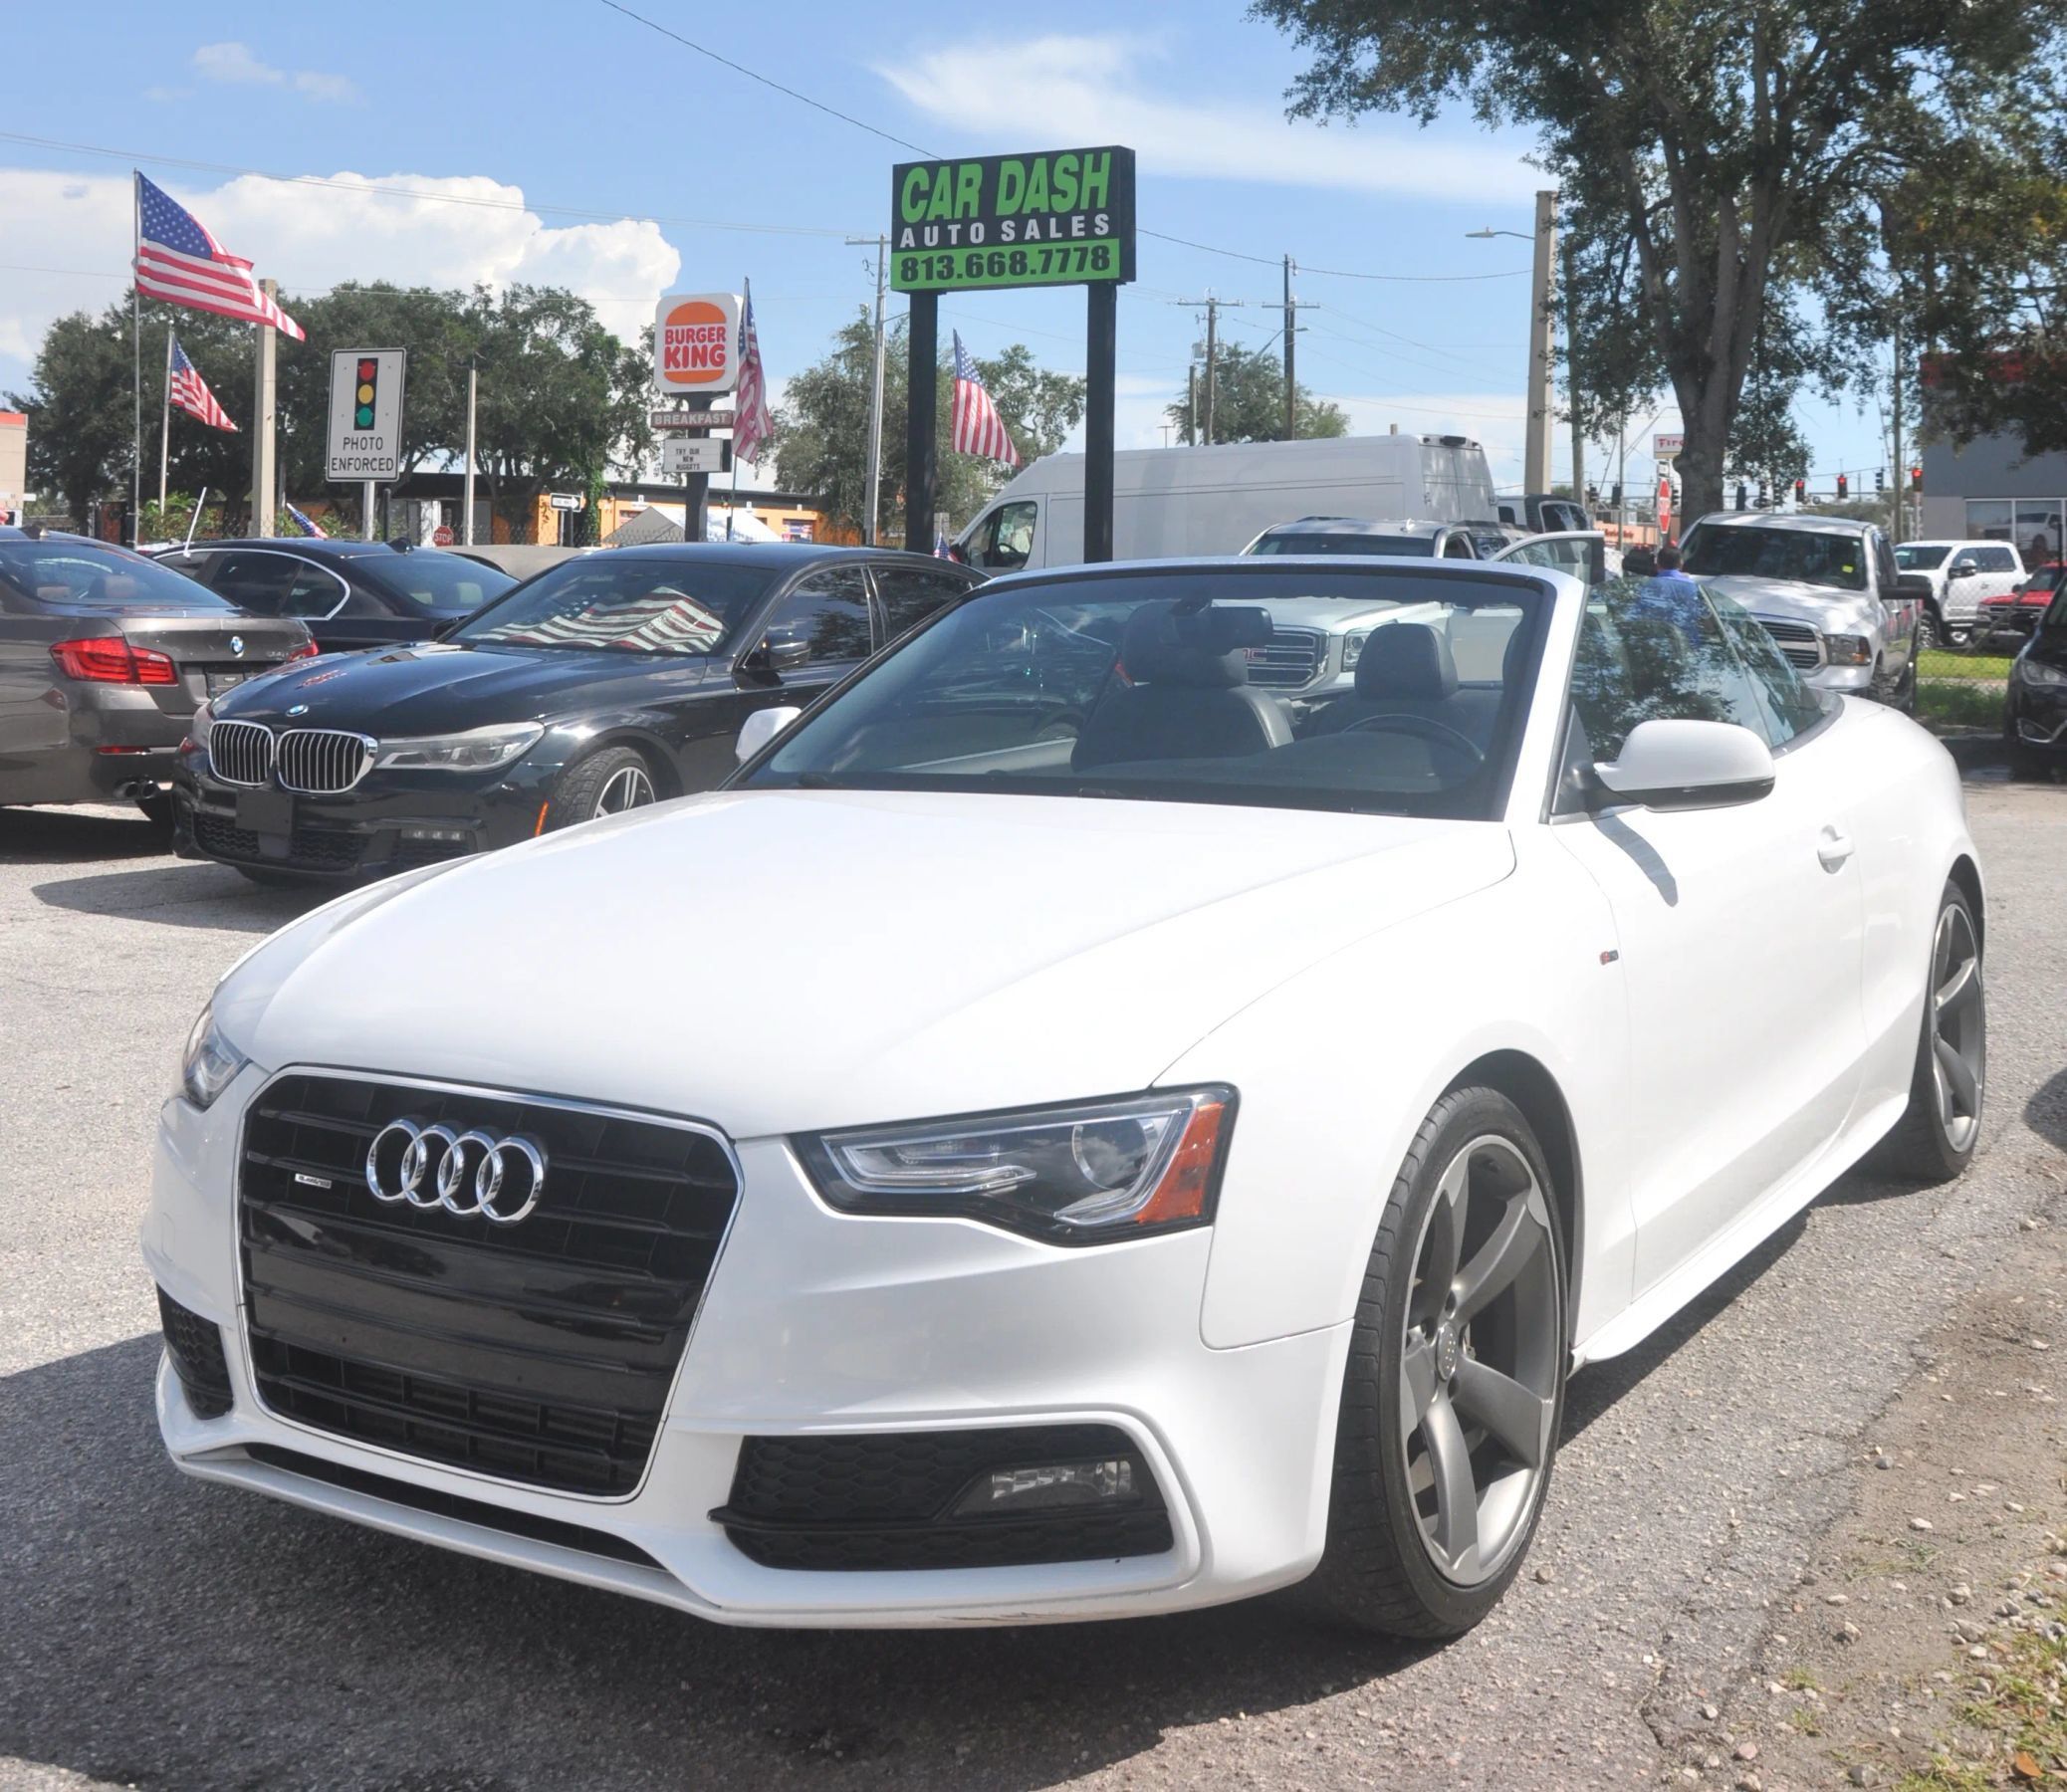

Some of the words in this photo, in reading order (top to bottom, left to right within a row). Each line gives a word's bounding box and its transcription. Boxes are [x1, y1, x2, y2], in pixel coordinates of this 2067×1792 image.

[901, 162, 984, 224] CAR
[996, 151, 1112, 216] DASH
[899, 222, 986, 249] AUTO
[1001, 213, 1110, 242] SALES
[899, 245, 1111, 283] 813.668.7778
[664, 326, 727, 345] BURGER
[663, 343, 727, 369] KING
[653, 412, 729, 426] BREAKFAST
[343, 436, 383, 451] PHOTO
[331, 457, 394, 472] ENFORCED
[434, 533, 453, 543] STOP
